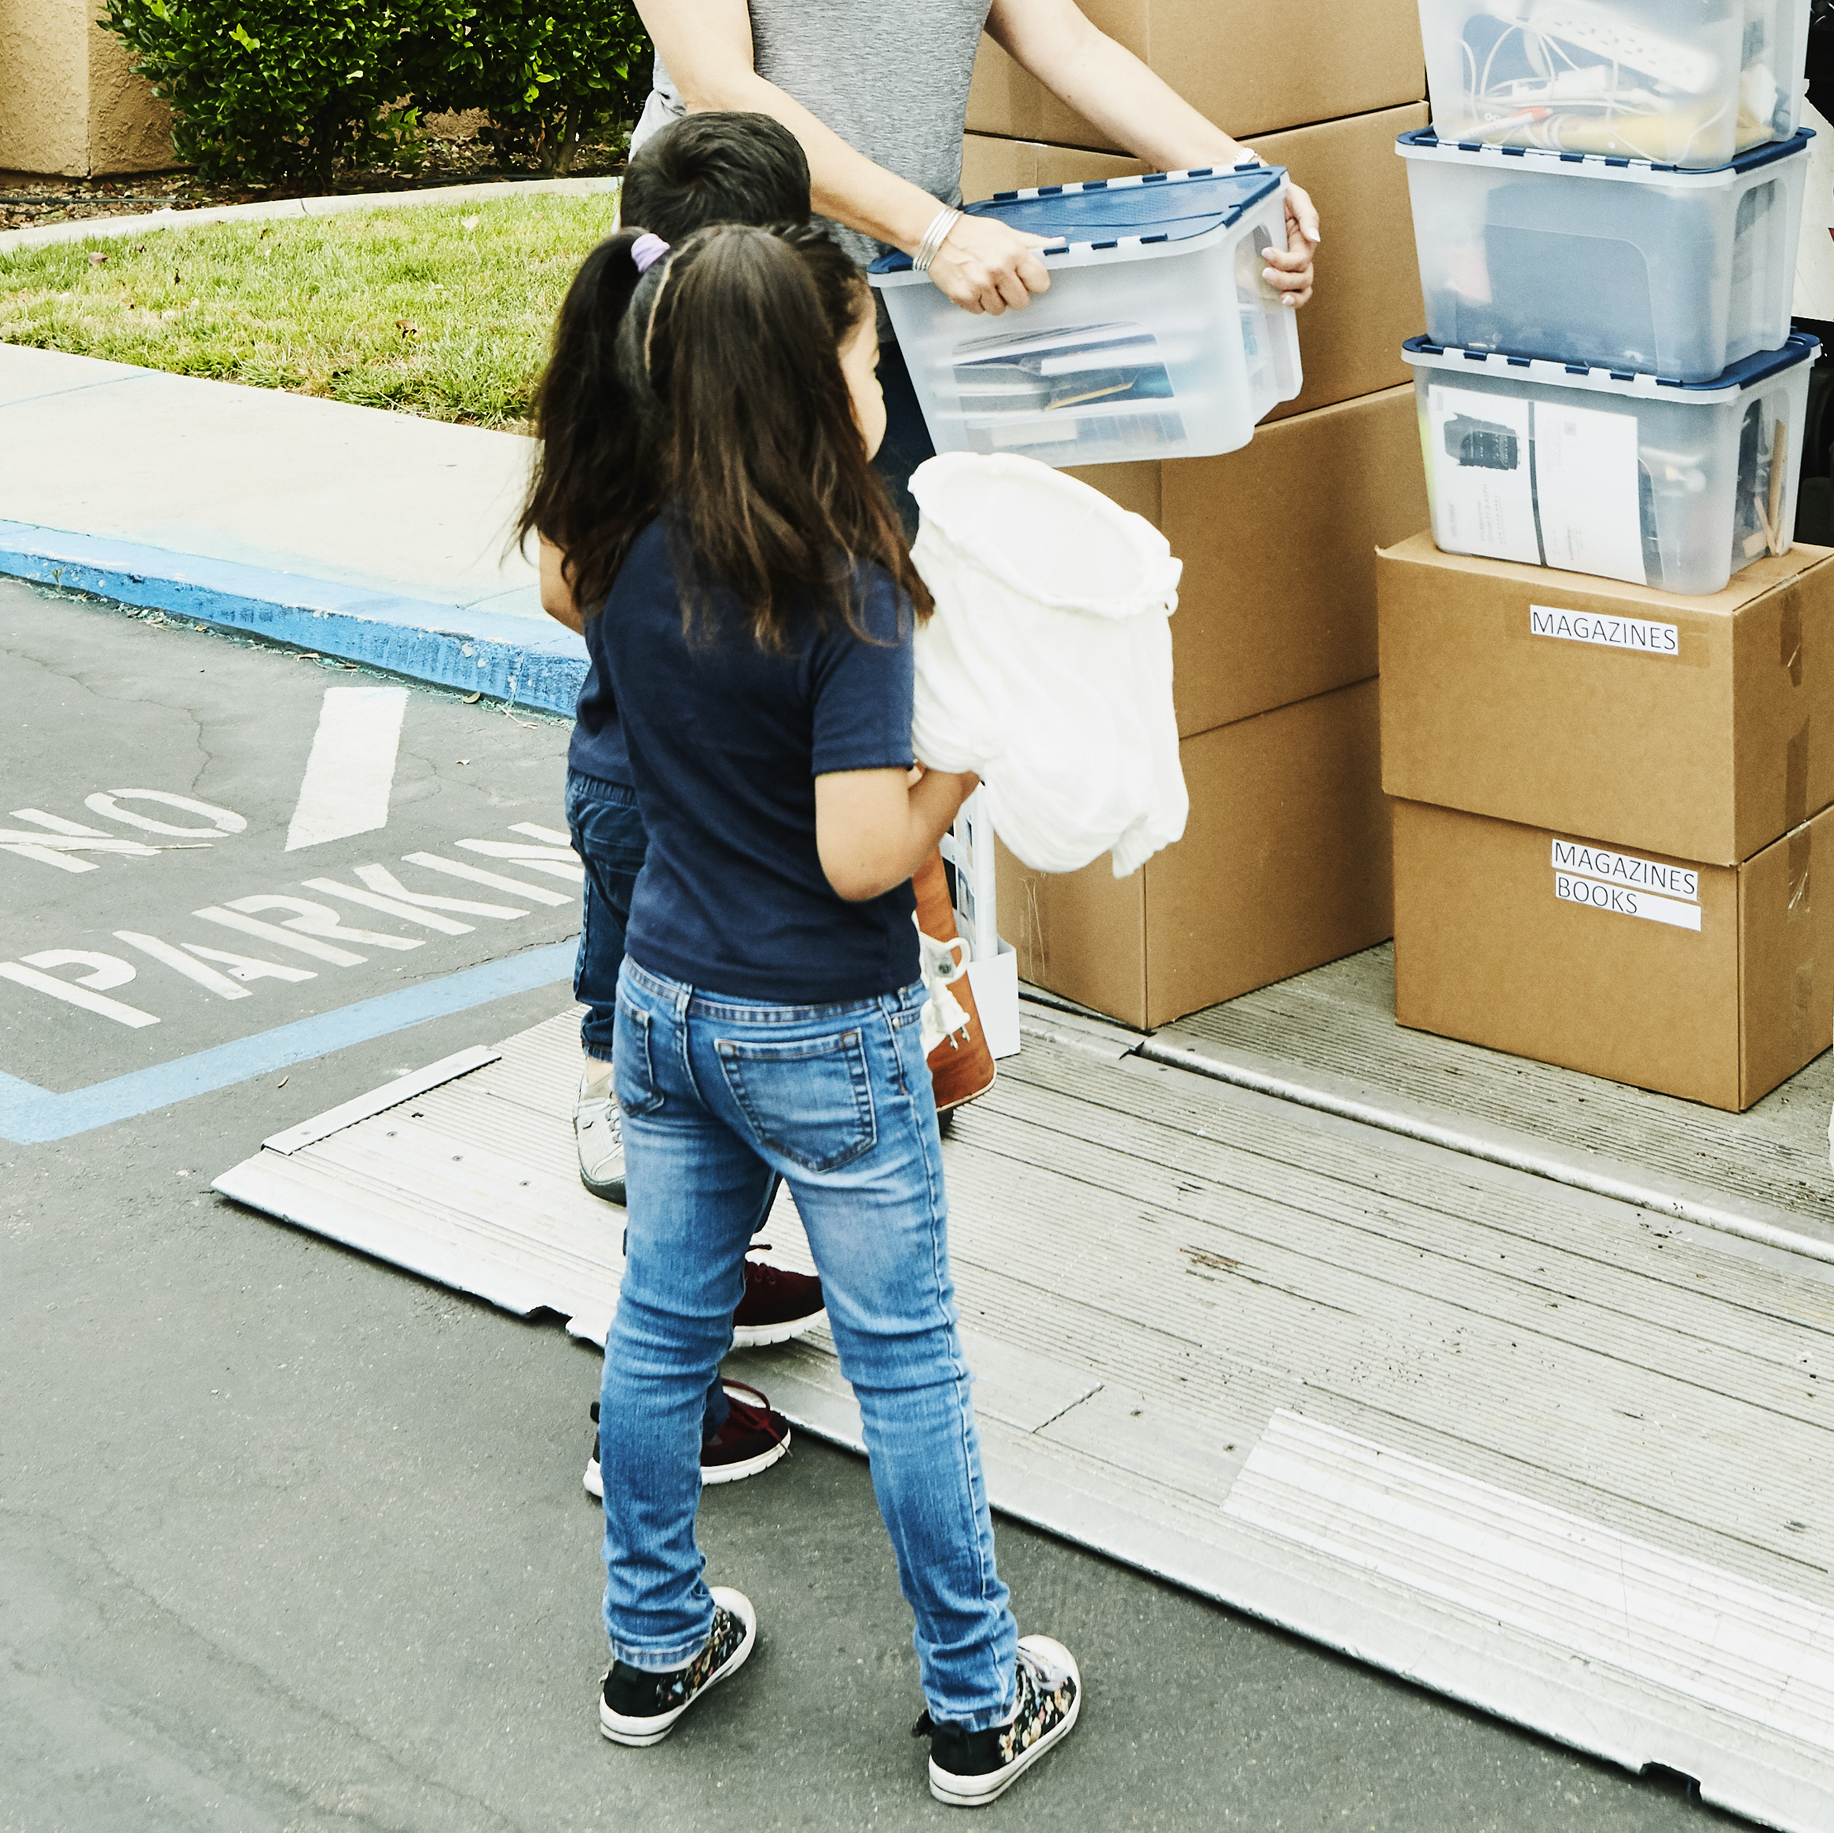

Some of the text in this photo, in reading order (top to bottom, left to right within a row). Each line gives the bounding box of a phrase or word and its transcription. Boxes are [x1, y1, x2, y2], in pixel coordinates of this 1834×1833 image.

[1532, 611, 1677, 651] MAGAZINES
[1555, 842, 1696, 895] MAGAZINES
[1557, 876, 1638, 914] BOOKS
